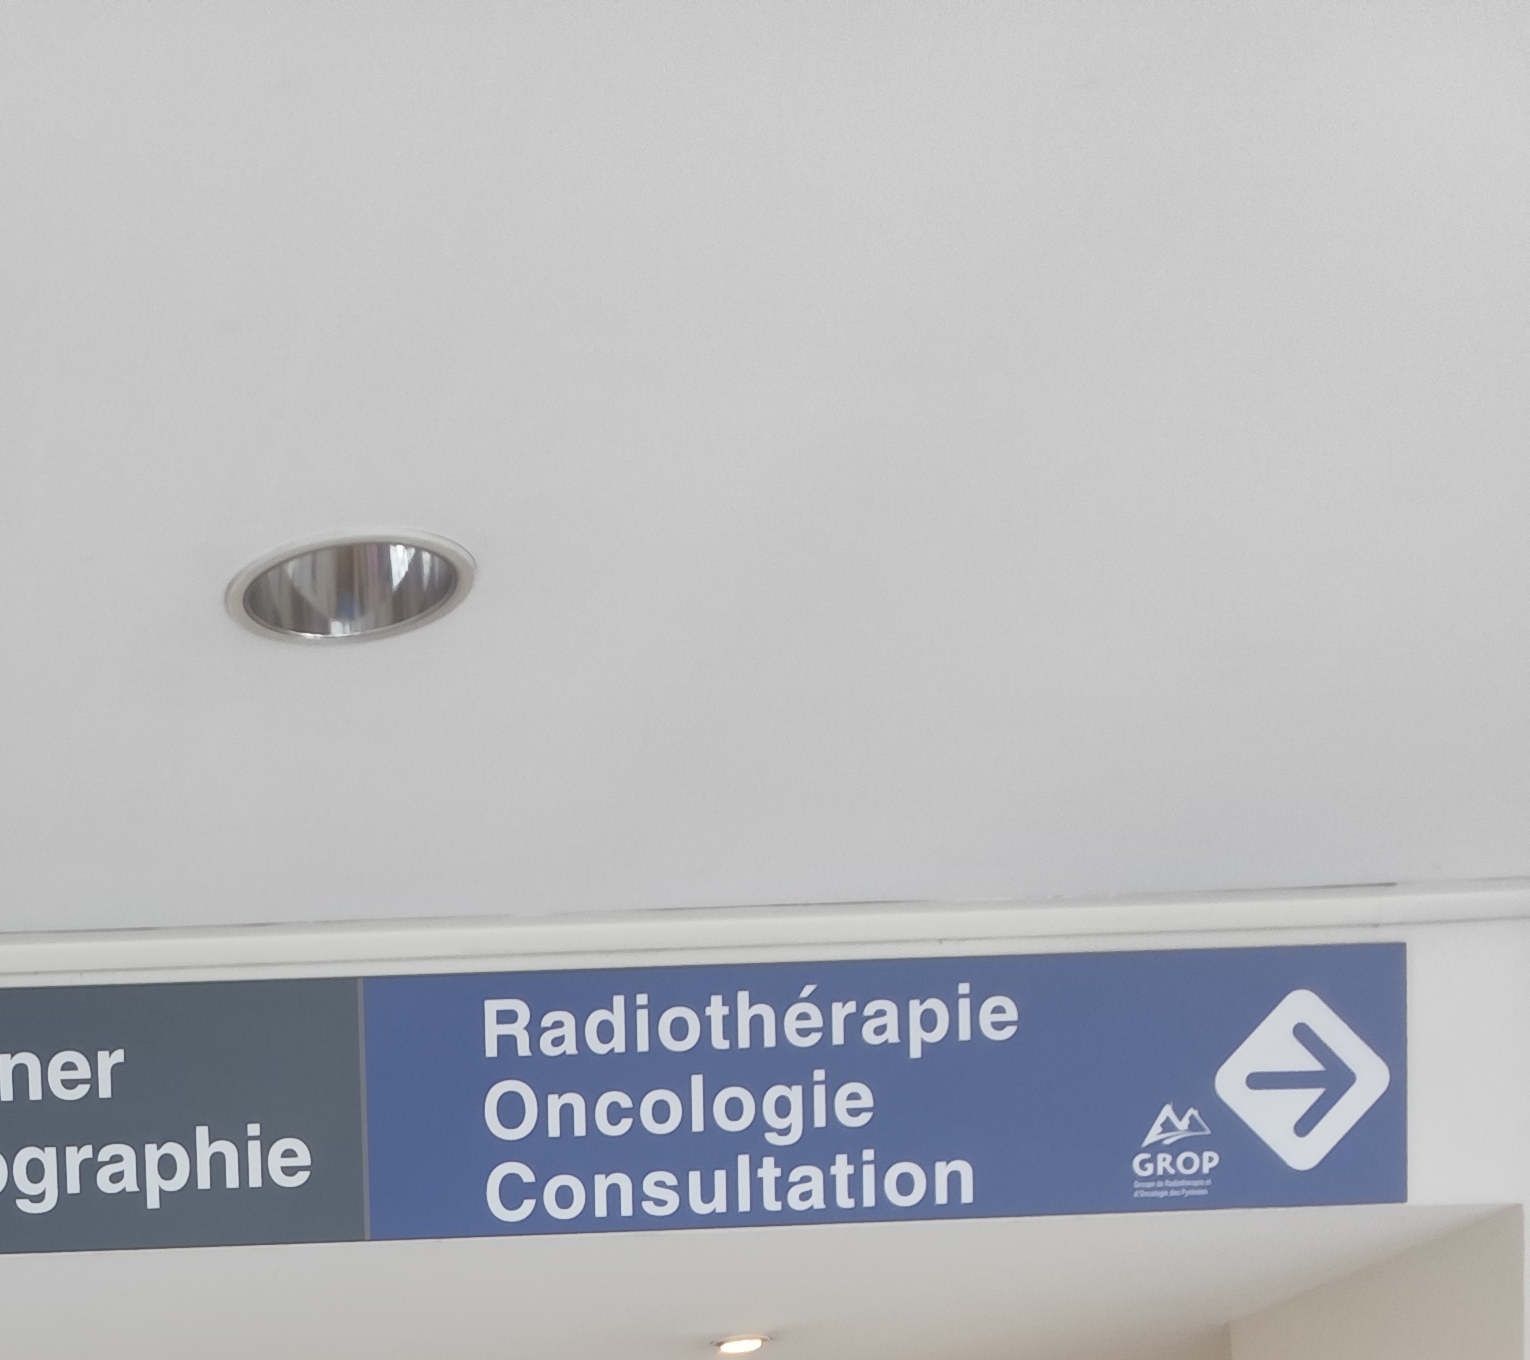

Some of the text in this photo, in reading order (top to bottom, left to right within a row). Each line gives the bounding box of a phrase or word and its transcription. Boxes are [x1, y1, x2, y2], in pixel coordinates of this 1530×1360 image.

[483, 982, 1020, 1060] Radiothérapie
[484, 1068, 875, 1147] Oncologie
[485, 1149, 976, 1224] Consultation
[1132, 1150, 1220, 1177] GROP
